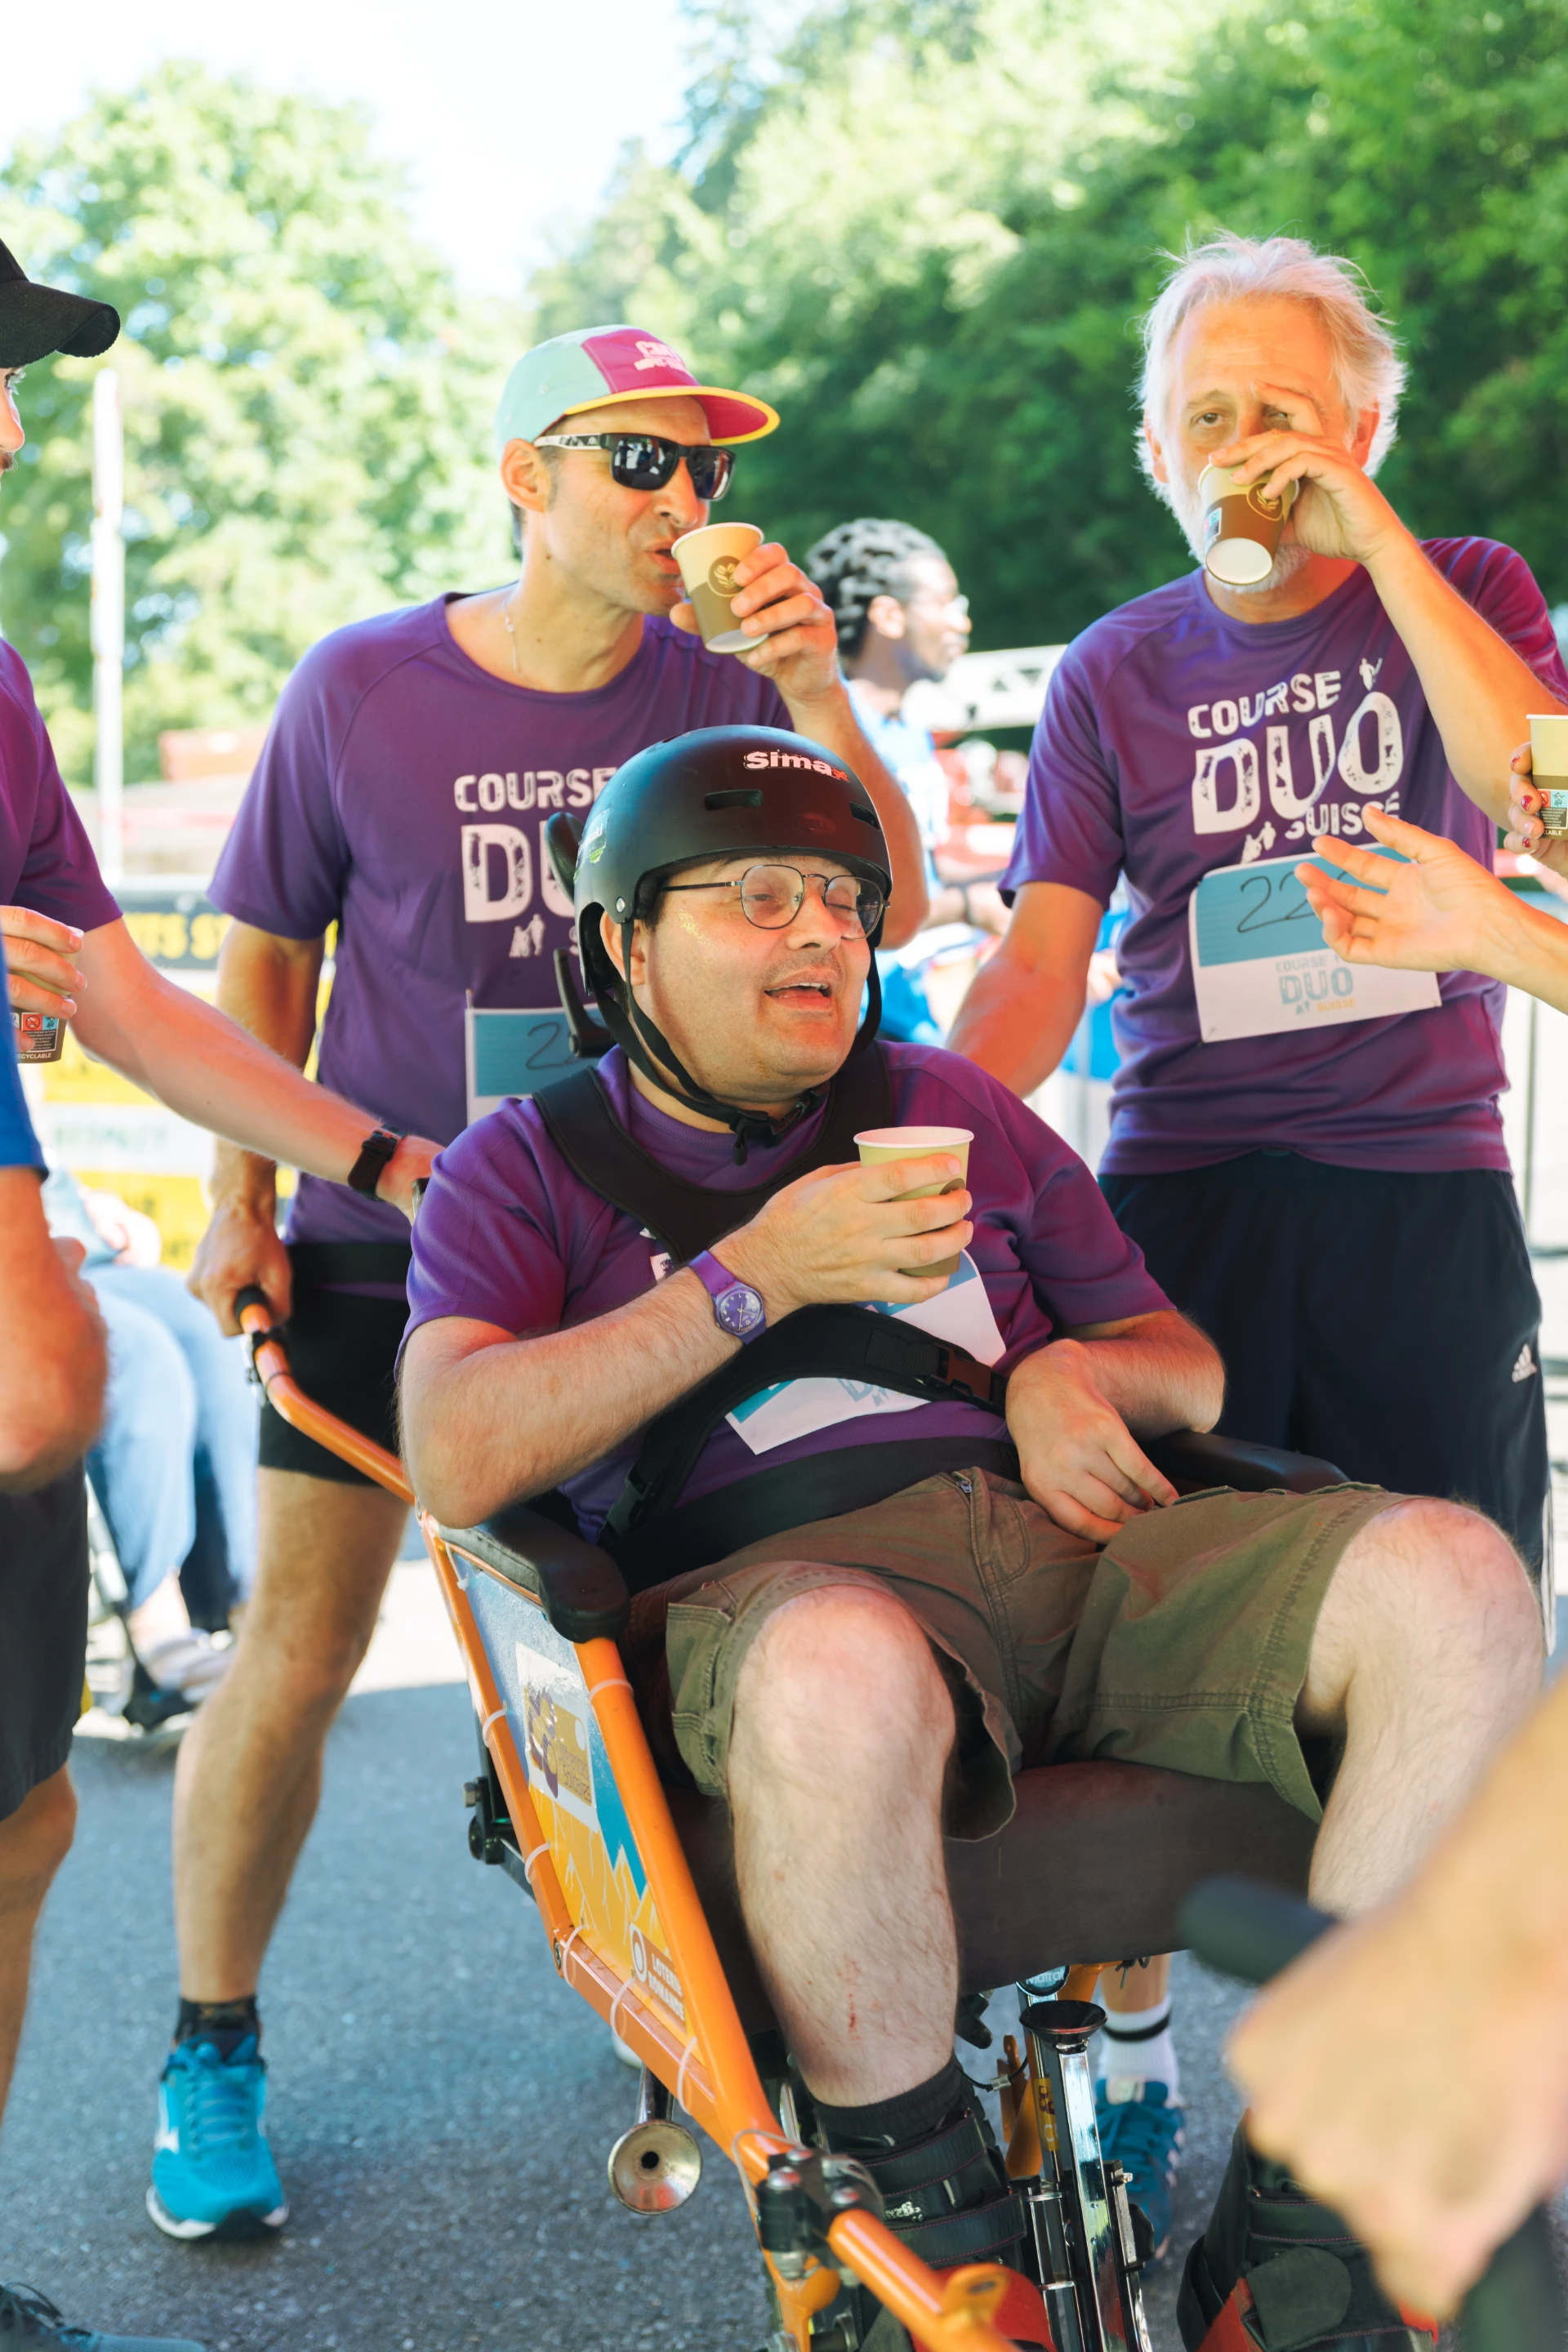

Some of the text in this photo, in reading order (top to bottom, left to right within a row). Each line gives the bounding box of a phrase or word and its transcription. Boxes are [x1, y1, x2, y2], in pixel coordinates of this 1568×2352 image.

[1187, 670, 1342, 738] COURSE
[1192, 691, 1404, 835] DUO
[1276, 953, 1328, 973] COURSE
[1279, 966, 1354, 1005] DUO
[1316, 997, 1356, 1013] SUISSE
[16, 1052, 51, 1060] ECYCLABLE
